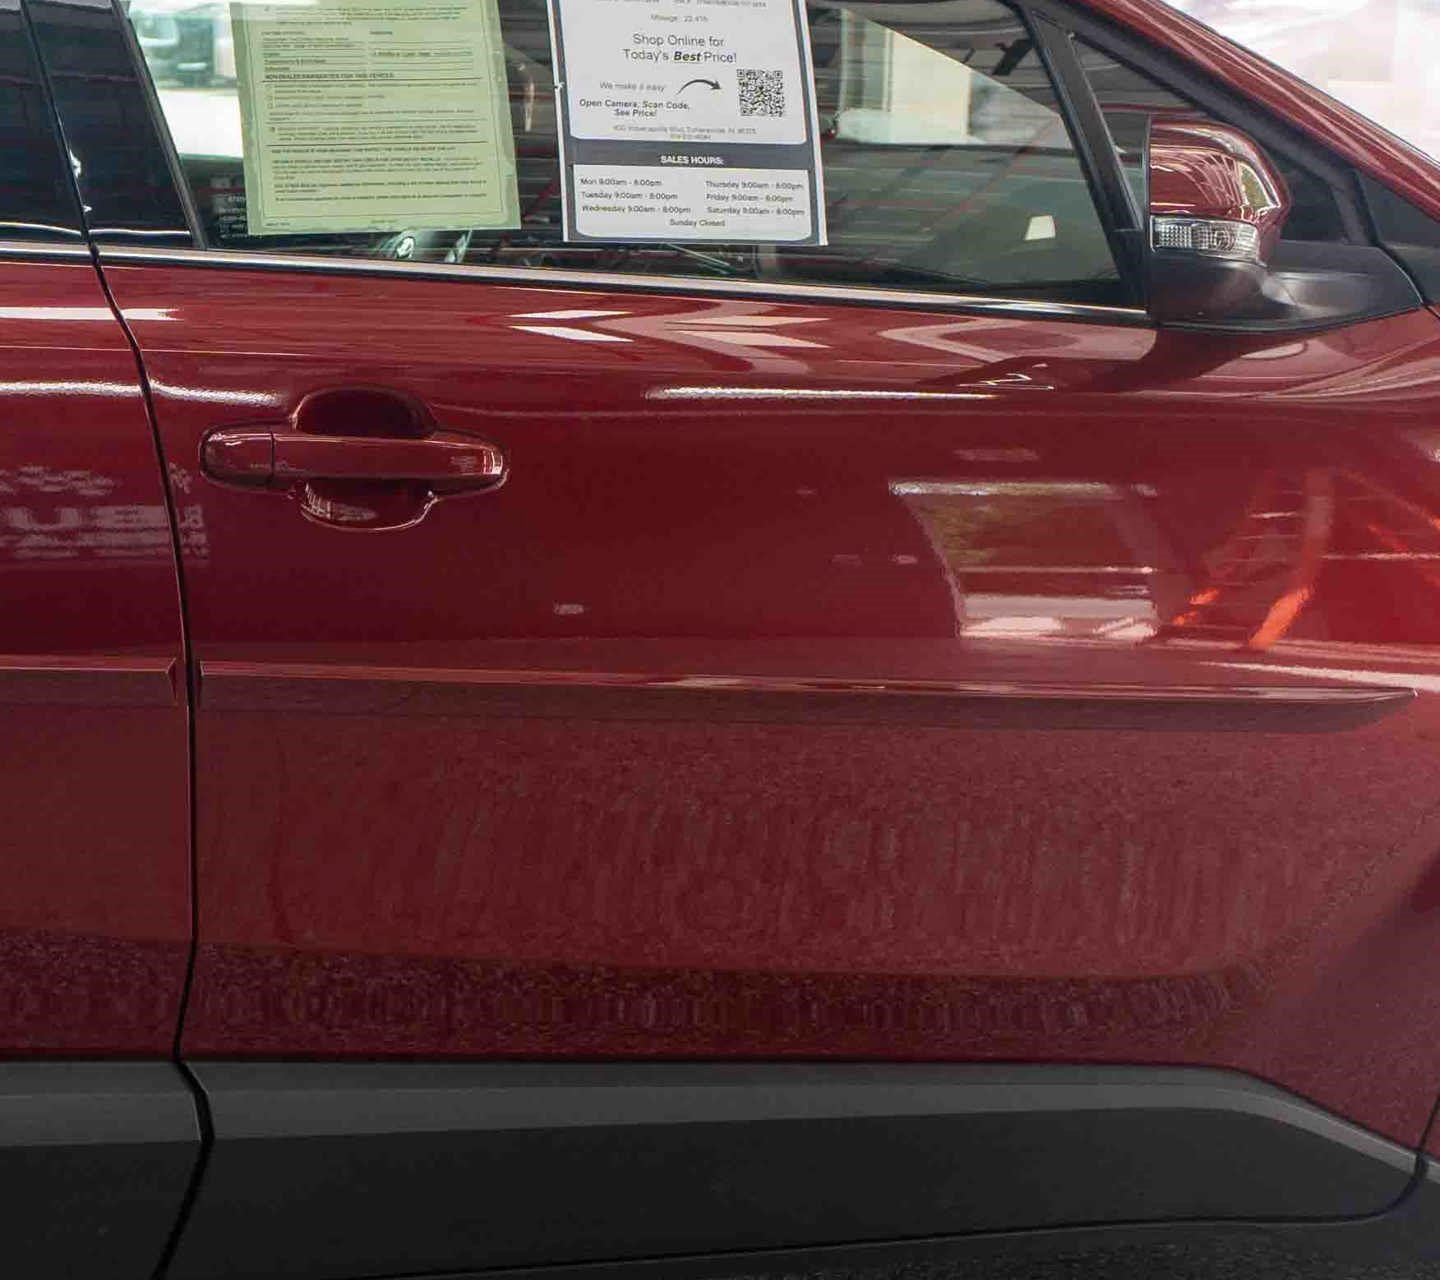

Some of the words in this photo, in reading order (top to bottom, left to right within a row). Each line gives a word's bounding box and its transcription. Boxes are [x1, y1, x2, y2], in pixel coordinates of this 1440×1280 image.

[633, 33, 664, 46] Shop
[667, 35, 705, 46] Online
[709, 35, 724, 47] for
[623, 48, 669, 61] Today's
[674, 51, 701, 62] Best
[704, 51, 737, 63] Price!
[580, 98, 602, 107] Open
[642, 100, 663, 108] Scan
[614, 108, 630, 116] See
[660, 155, 689, 164] SALES
[690, 156, 724, 165] HOURS:
[706, 180, 739, 189] Thursday
[582, 192, 612, 200] Tuesday
[582, 205, 626, 213] Wednesday
[707, 207, 741, 215] Saturday
[669, 219, 697, 227] Sunday
